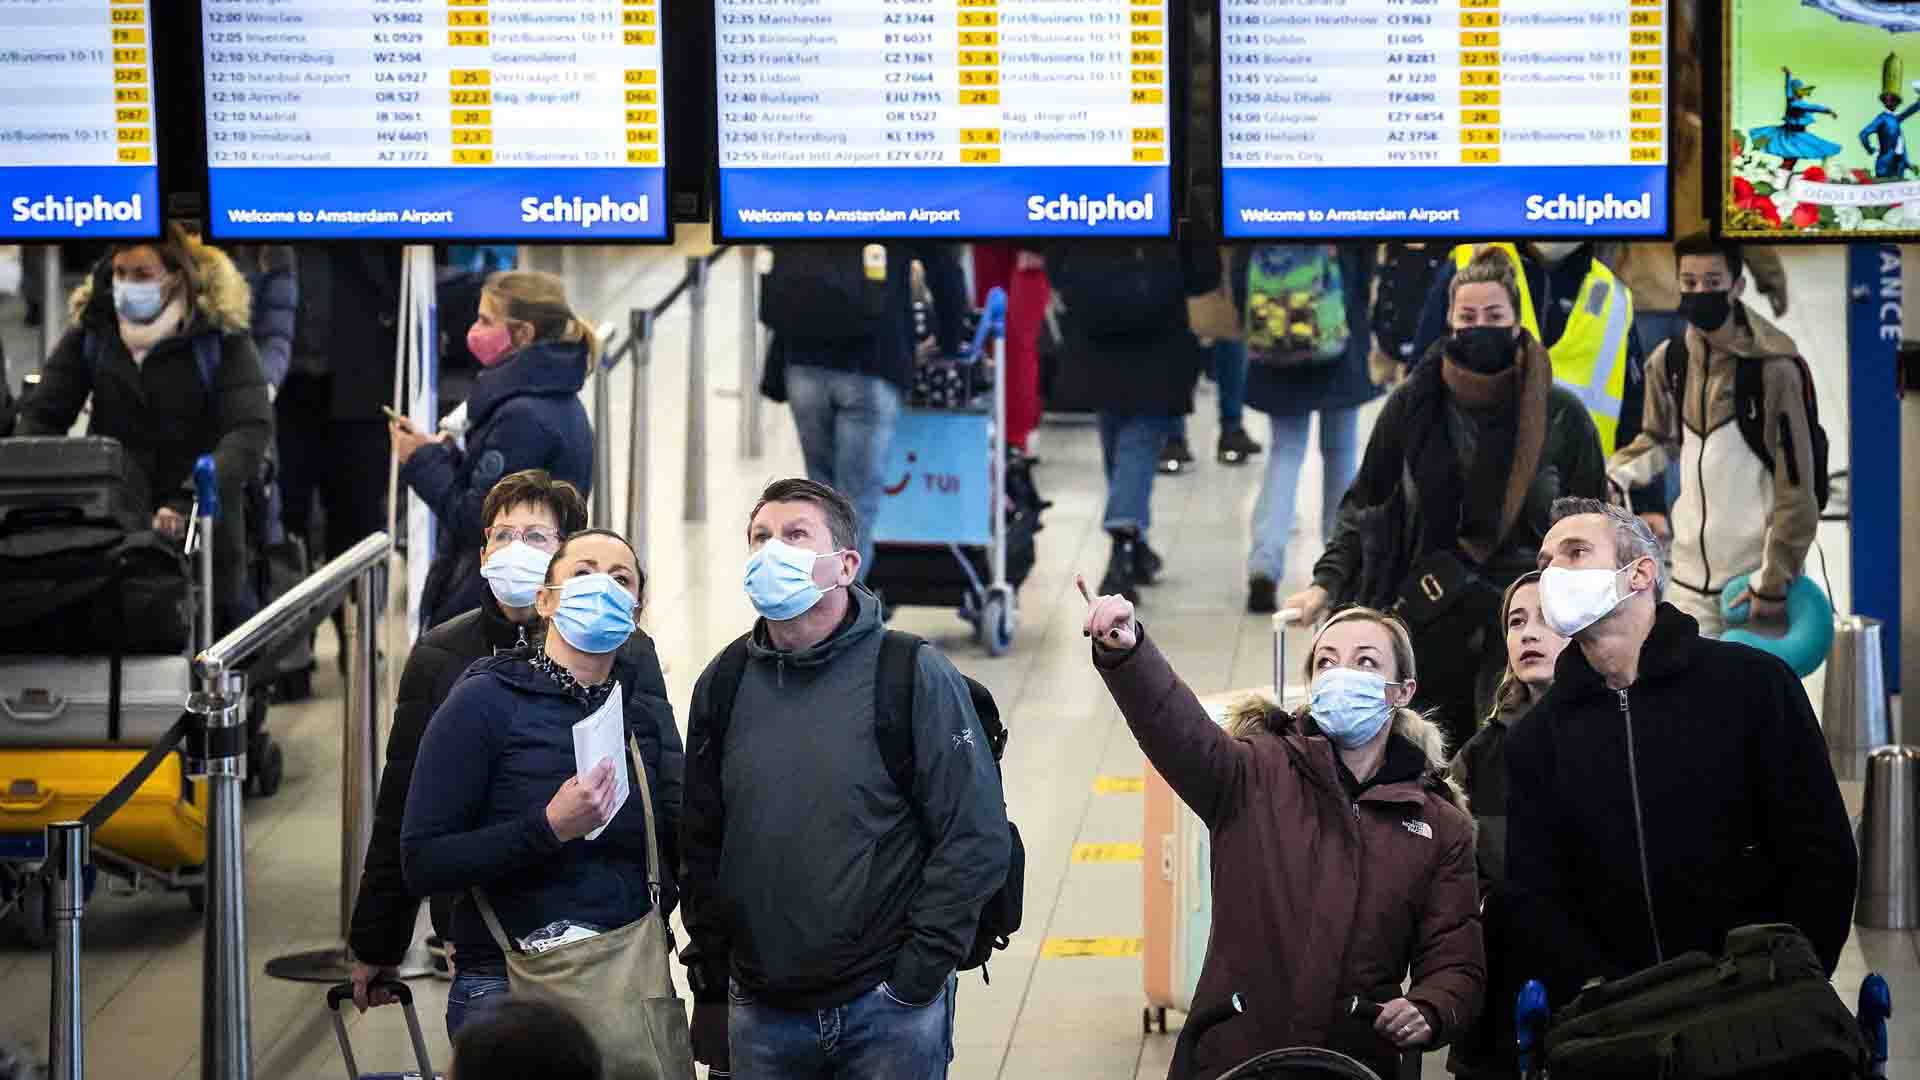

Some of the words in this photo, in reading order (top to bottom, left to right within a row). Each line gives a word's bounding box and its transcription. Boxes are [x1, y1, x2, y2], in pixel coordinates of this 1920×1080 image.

[12, 194, 142, 227] Schiphol
[228, 209, 293, 224] Welcome
[298, 210, 314, 223] to
[318, 208, 398, 224] Amsterdam
[402, 208, 454, 227] Airport
[521, 194, 650, 226] Schiphol
[739, 209, 802, 224] Welcome
[807, 210, 823, 223] to
[826, 208, 905, 224] Amsterdam
[909, 208, 960, 227] Airport
[1028, 194, 1153, 226] Schiphol
[1241, 209, 1304, 224] Welcome
[1309, 210, 1324, 223] to
[1326, 208, 1406, 224] Amsterdam
[1409, 208, 1460, 227] Airport
[1527, 193, 1652, 225] Schiphol
[924, 474, 960, 493] TUI
